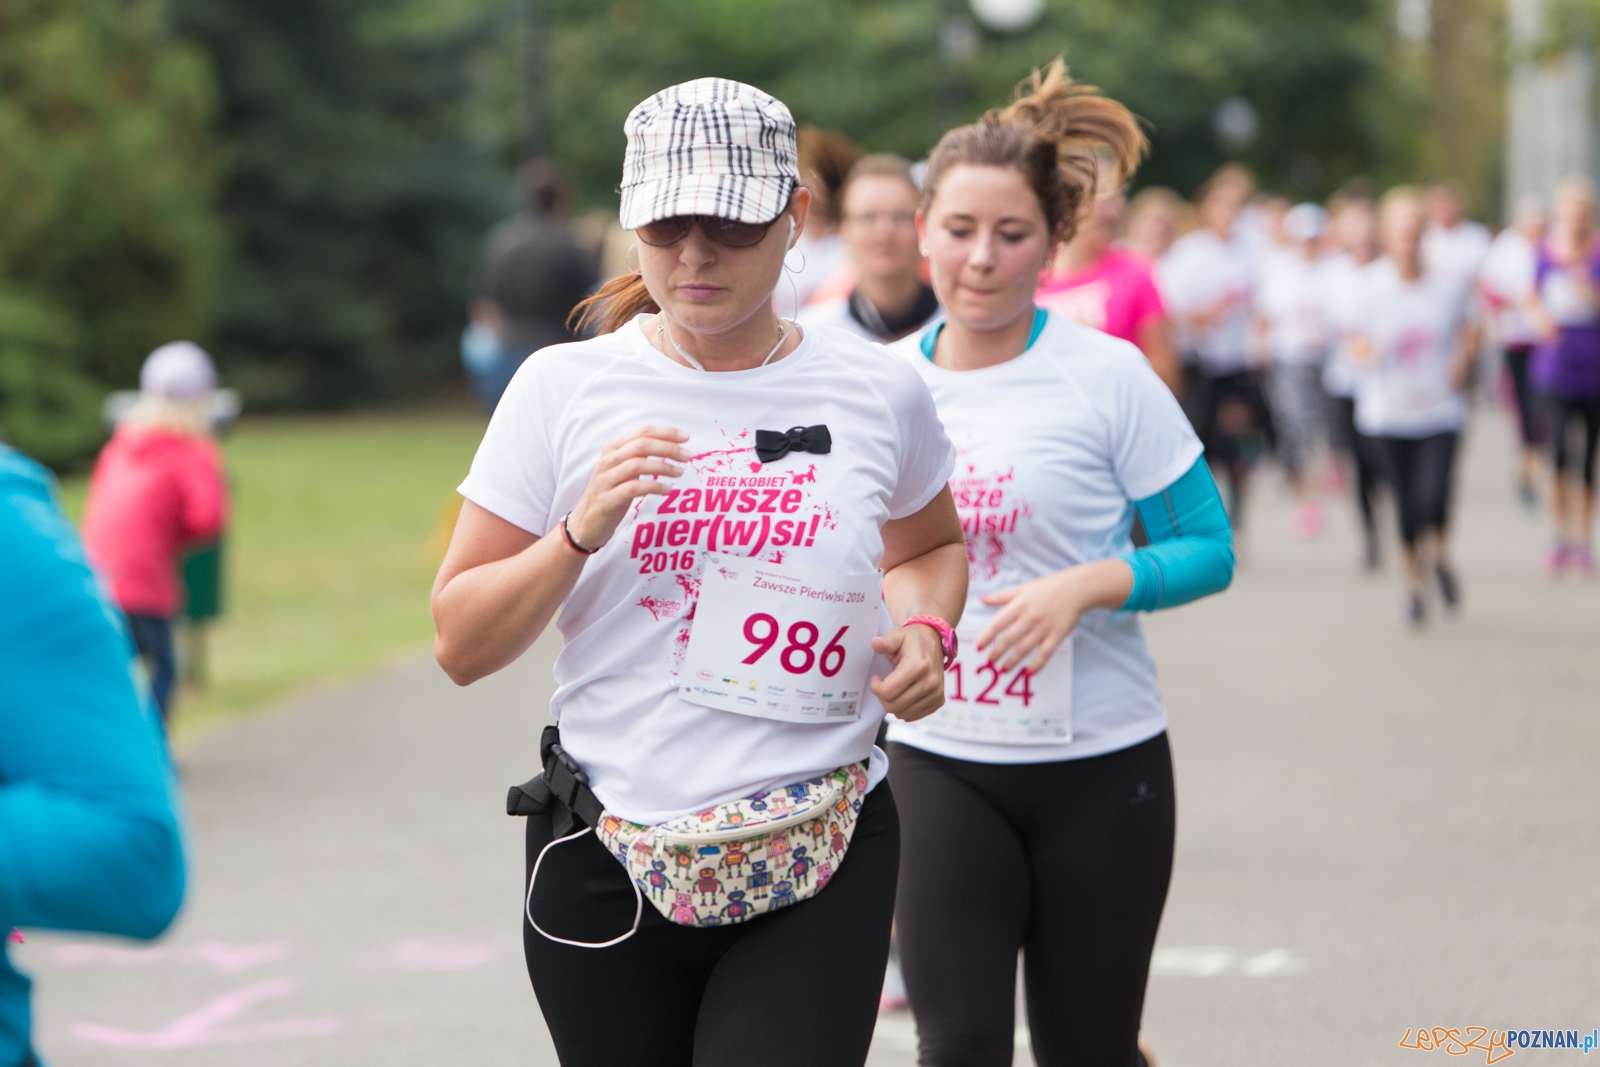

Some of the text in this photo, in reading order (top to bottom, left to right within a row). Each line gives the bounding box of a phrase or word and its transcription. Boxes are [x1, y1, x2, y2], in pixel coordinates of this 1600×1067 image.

[706, 476, 787, 487] BIEG KOBIET
[657, 488, 802, 514] zawsze
[630, 514, 821, 558] pier(w)si!
[639, 550, 694, 574] 2016
[752, 576, 866, 603] Zawsze Pier(w)si 2016
[740, 612, 850, 678] 986
[948, 661, 1034, 708] 124
